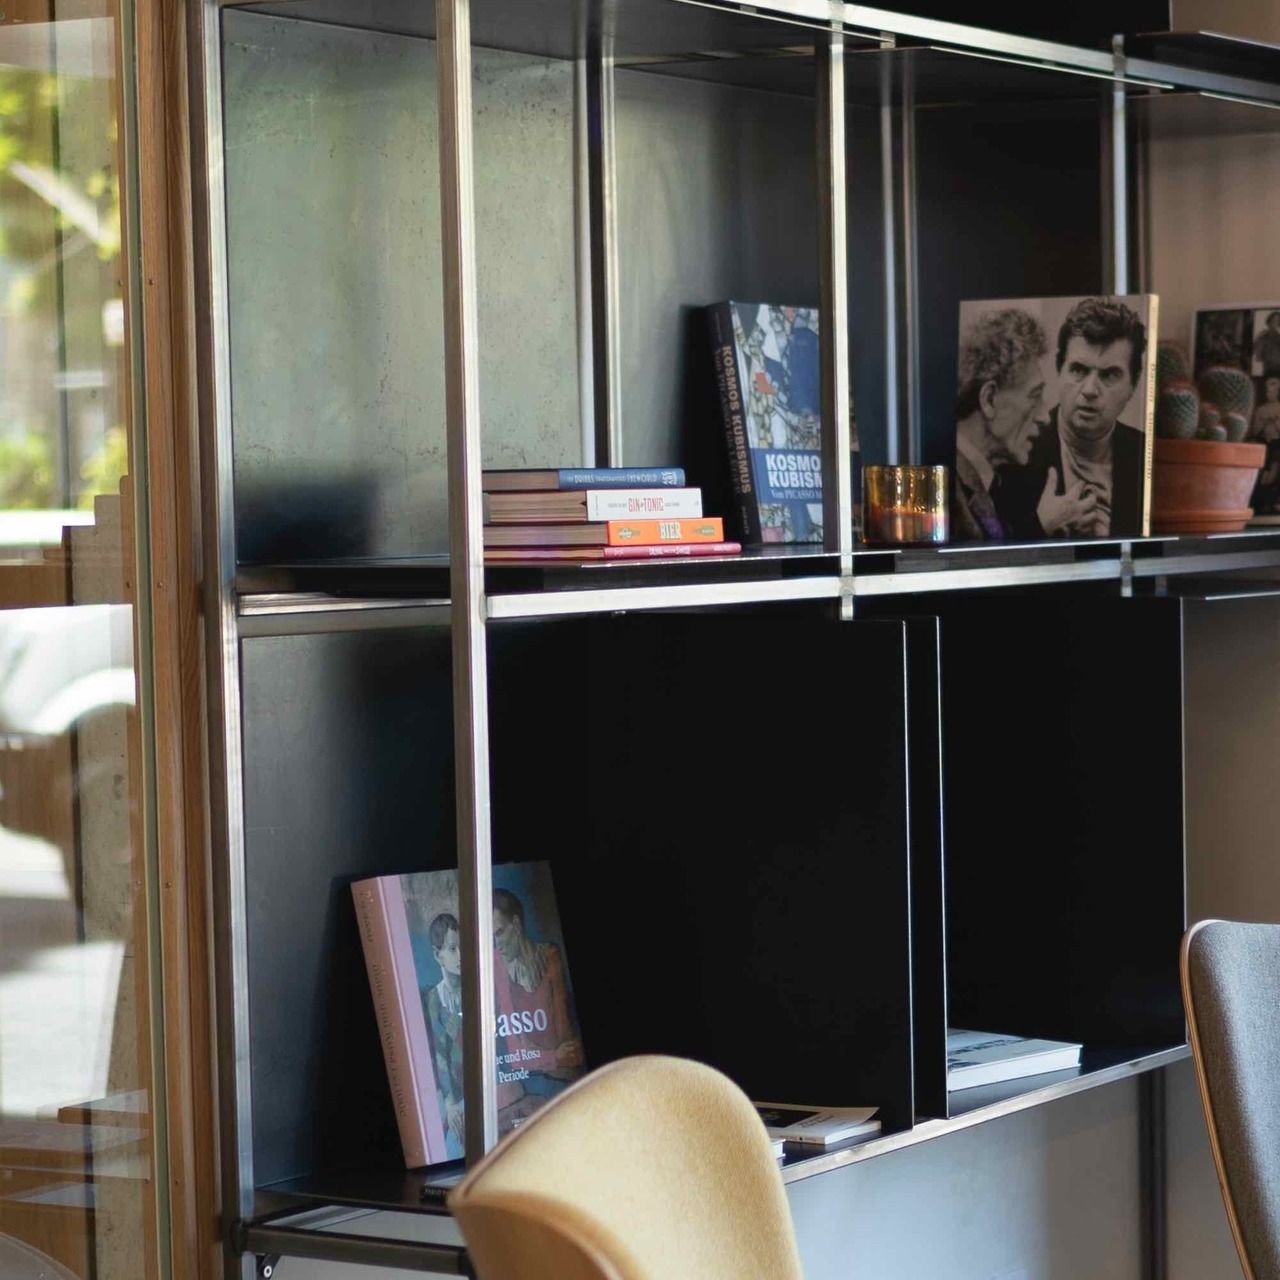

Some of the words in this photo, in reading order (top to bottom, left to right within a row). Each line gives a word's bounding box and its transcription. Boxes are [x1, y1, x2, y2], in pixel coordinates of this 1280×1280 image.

[722, 345, 740, 411] KOSMOS
[731, 415, 752, 494] KUBISMUS
[765, 454, 822, 471] KOSMO
[628, 497, 640, 512] GIN
[643, 497, 664, 512] TONIC
[660, 522, 681, 539] BIER
[496, 1008, 548, 1038] asso
[504, 1049, 521, 1064] und
[520, 1049, 541, 1061] Rosa
[498, 1067, 530, 1083] Periode
